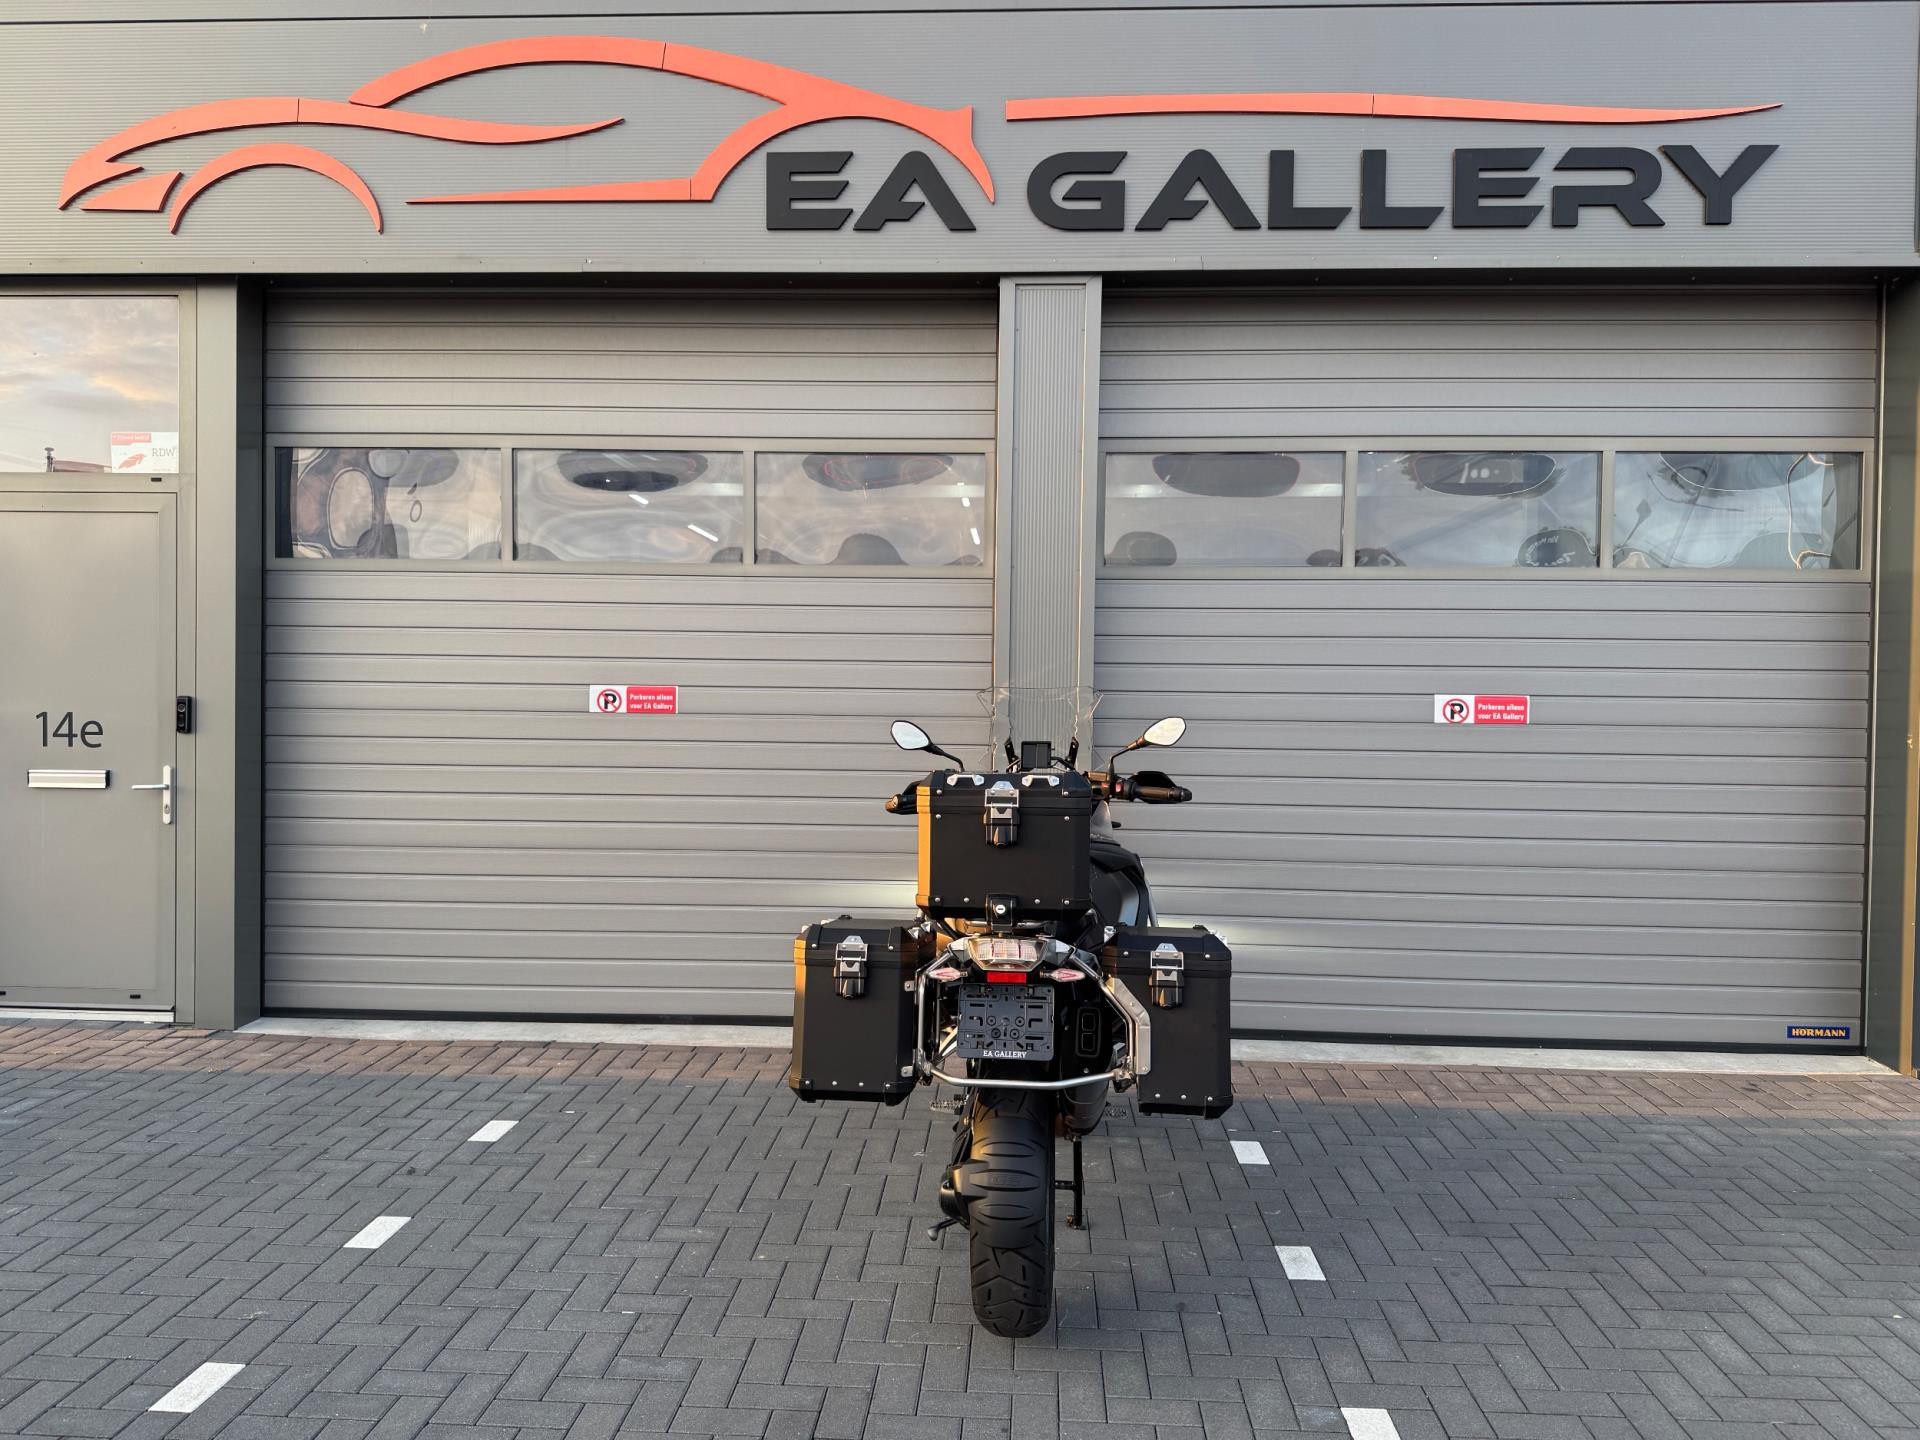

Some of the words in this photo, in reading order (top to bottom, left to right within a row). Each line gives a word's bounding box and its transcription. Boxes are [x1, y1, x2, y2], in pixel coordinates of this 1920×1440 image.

[766, 150, 976, 231] EA
[1026, 145, 1780, 231] GALLERY
[152, 447, 176, 457] RDW
[1503, 713, 1525, 721] Gallery
[36, 711, 104, 748] 14e
[994, 1050, 1027, 1058] GALLERY
